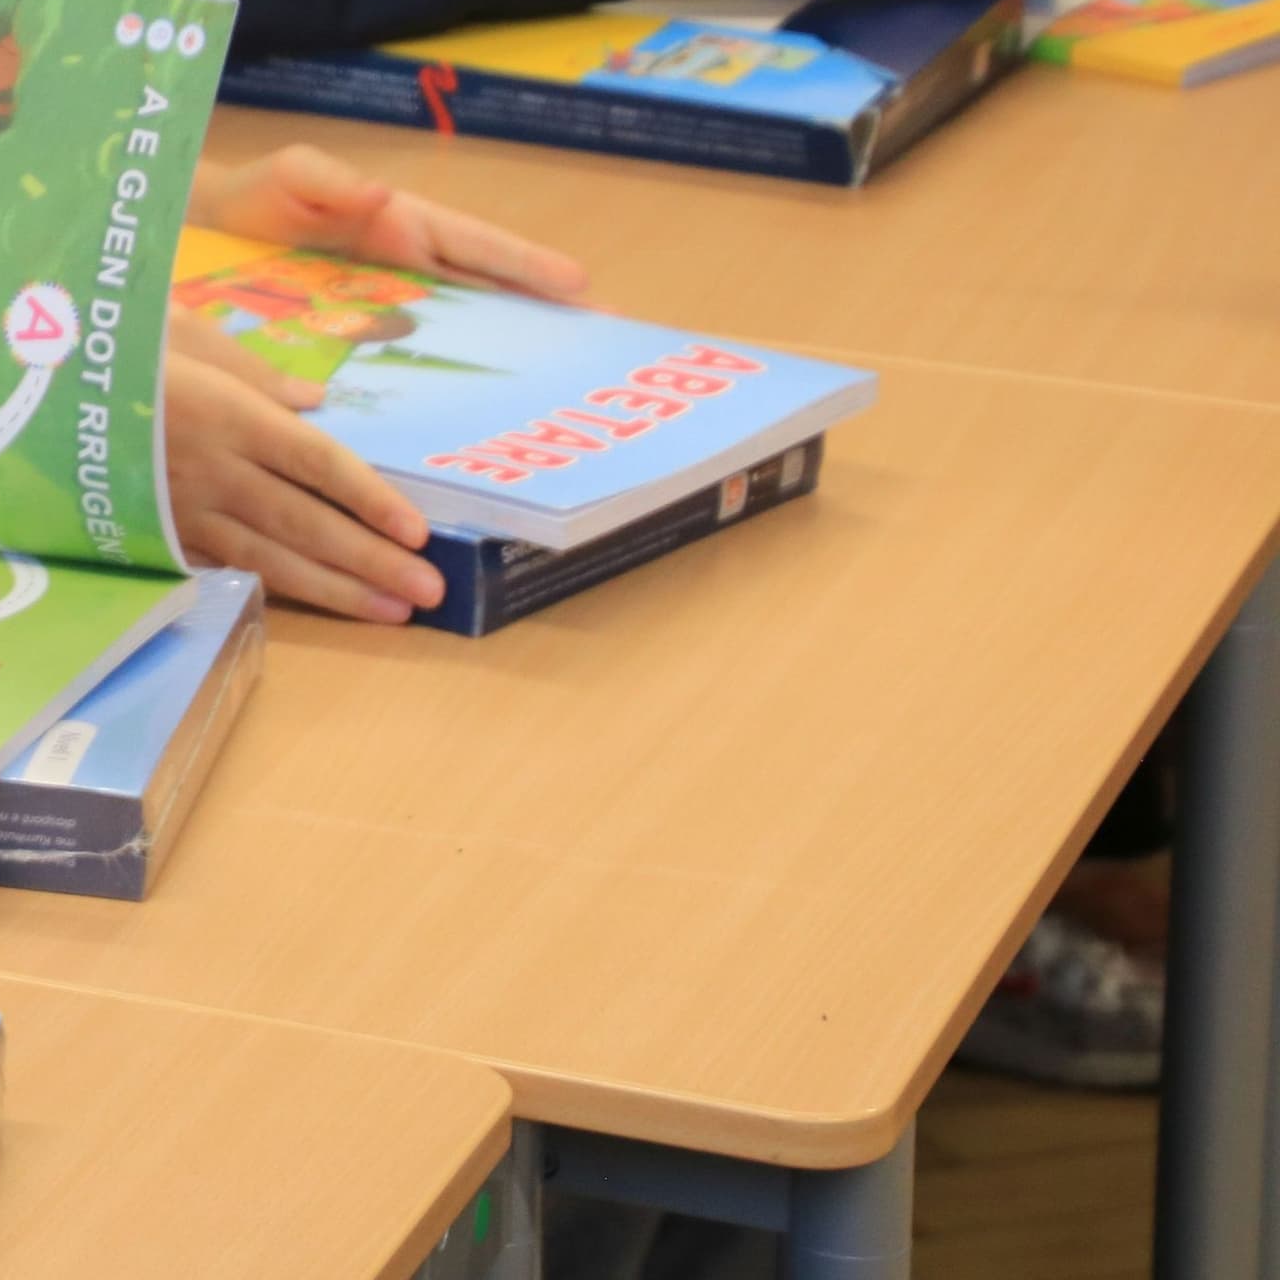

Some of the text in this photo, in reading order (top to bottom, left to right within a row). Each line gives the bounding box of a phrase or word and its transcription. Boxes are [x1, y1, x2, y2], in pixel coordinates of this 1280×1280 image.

[137, 84, 169, 116] A
[127, 128, 160, 157] E
[97, 169, 148, 286] GJEN
[16, 296, 64, 342] A
[81, 300, 121, 393] DOT
[423, 344, 768, 484] ABETARE
